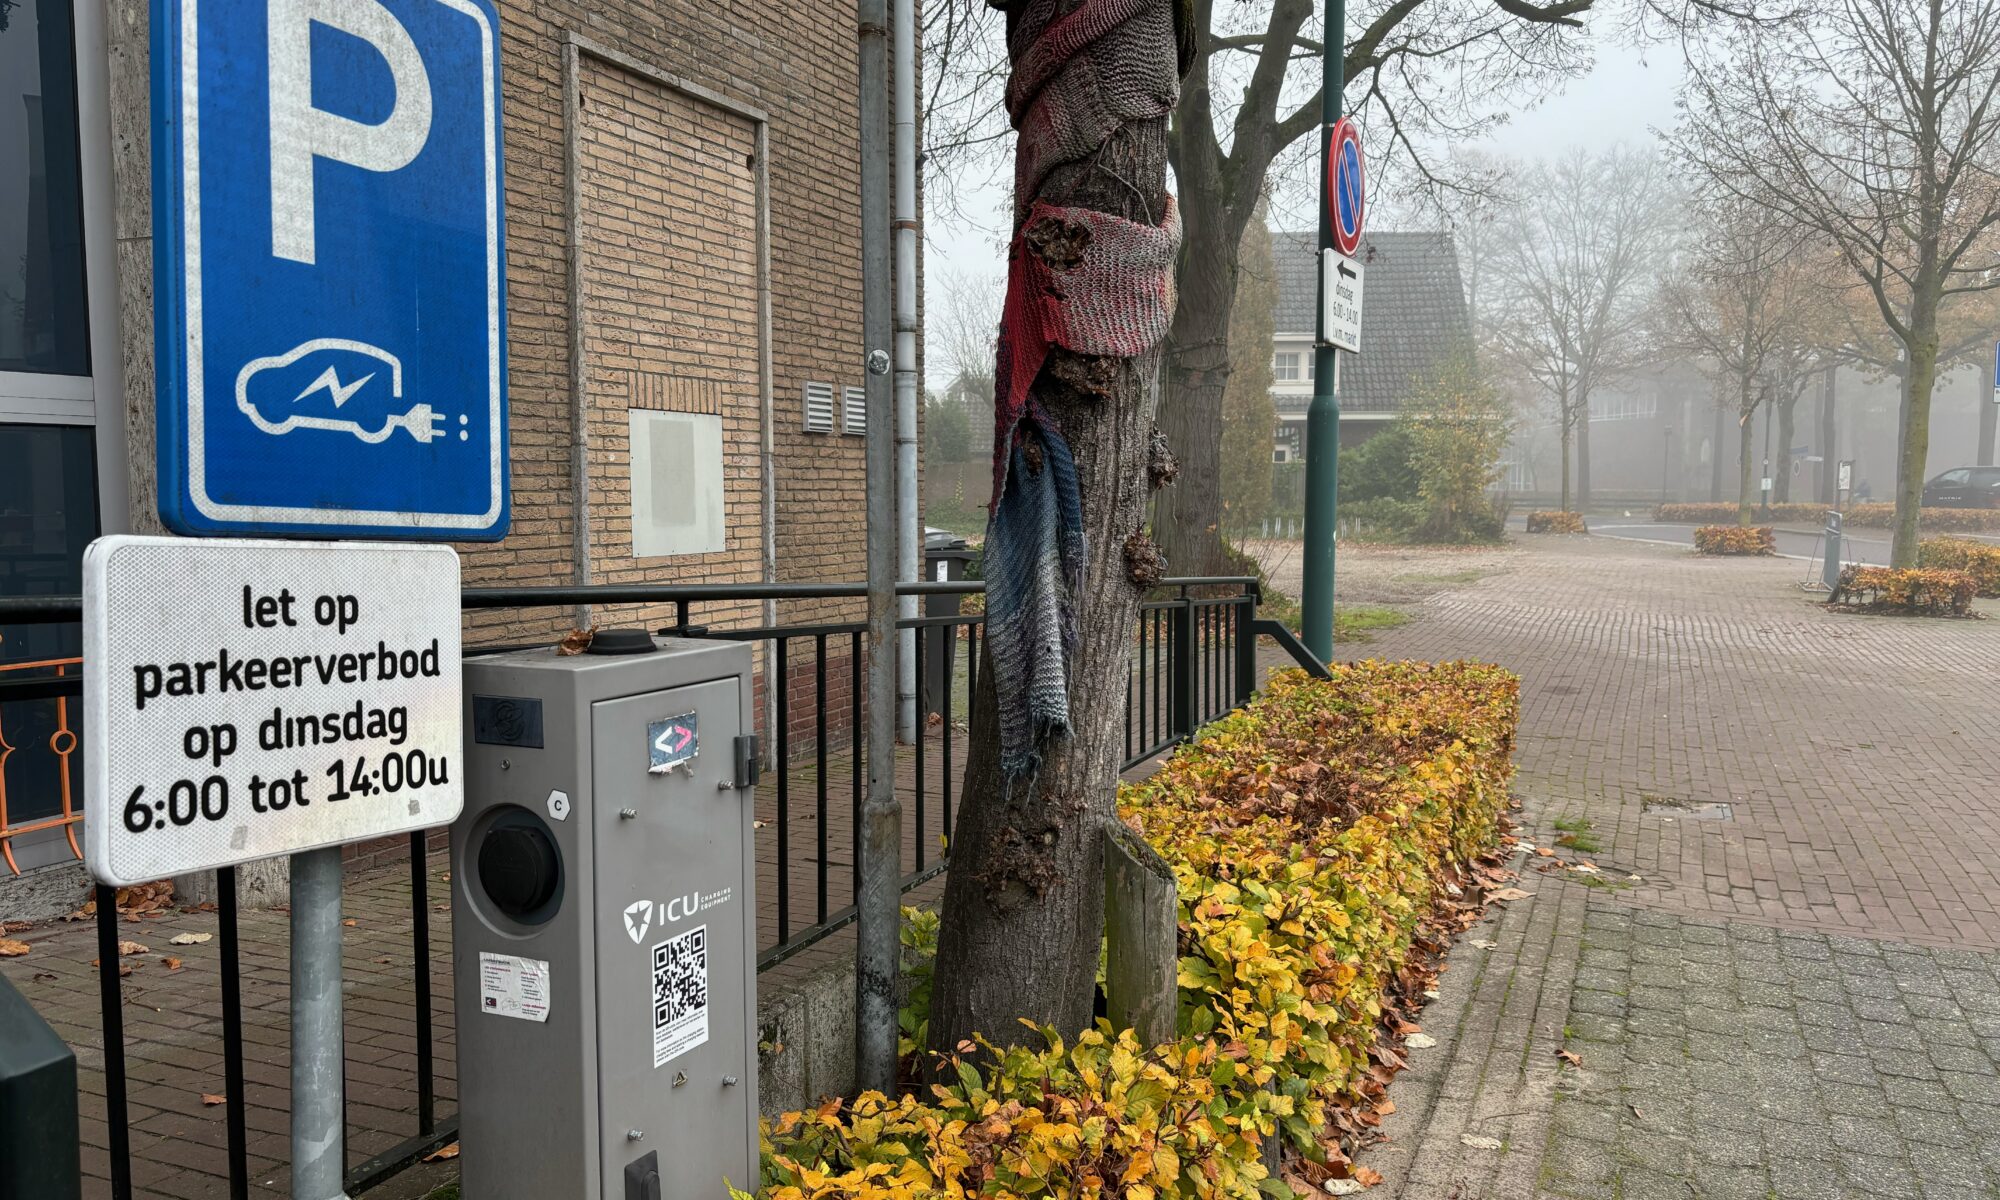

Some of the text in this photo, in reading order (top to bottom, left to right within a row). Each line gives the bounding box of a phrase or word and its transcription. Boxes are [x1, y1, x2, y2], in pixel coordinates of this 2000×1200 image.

[267, 0, 433, 265] P
[1336, 281, 1353, 305] dinsdag
[243, 585, 359, 634] let op
[134, 638, 441, 710] parkeerverbod
[183, 700, 408, 767] op dinsdag
[123, 749, 449, 834] 6:00 tot 14:00u
[554, 799, 562, 811] C
[659, 891, 699, 926] ICU
[700, 887, 732, 903] CHARGING
[700, 894, 732, 911] EQUIPMENT
